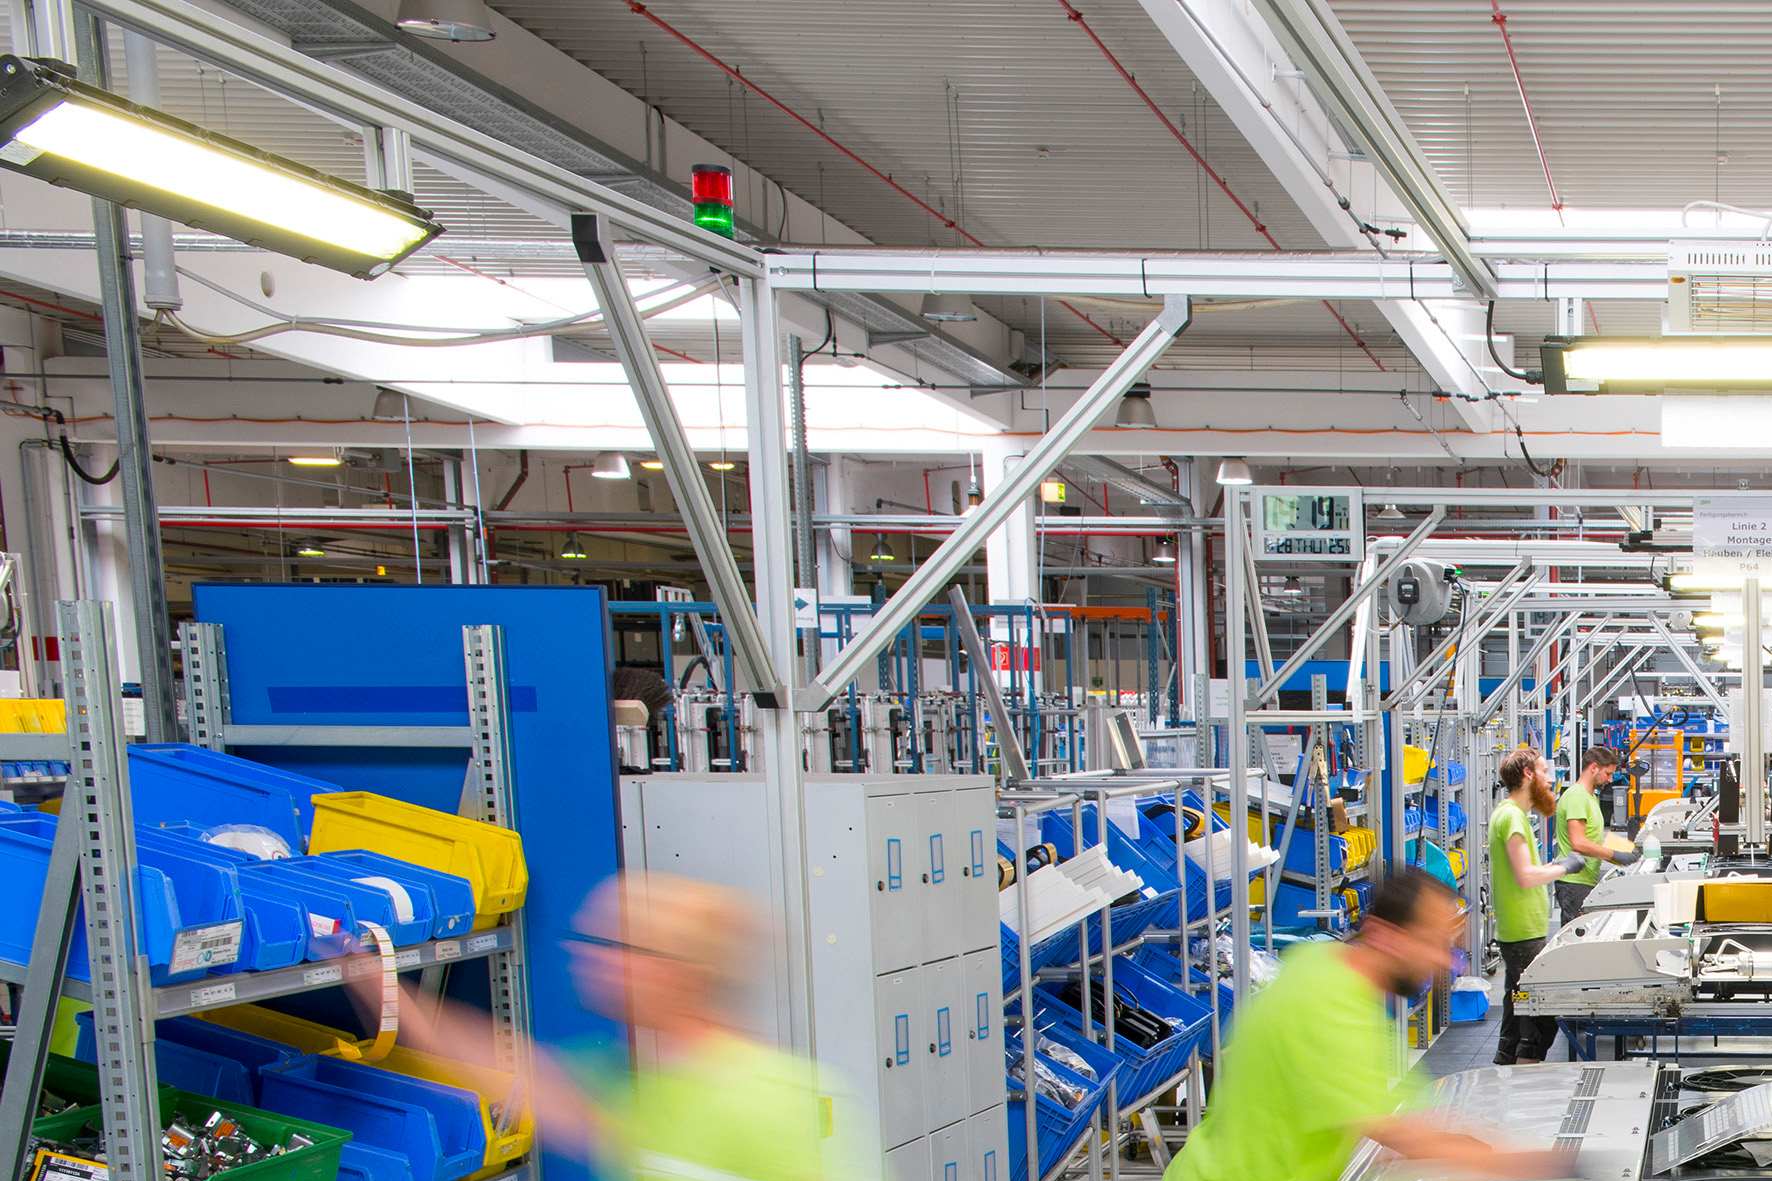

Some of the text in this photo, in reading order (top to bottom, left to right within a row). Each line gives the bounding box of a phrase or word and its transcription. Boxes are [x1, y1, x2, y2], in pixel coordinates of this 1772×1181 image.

[1732, 522, 1767, 531] Linie 2
[1727, 535, 1772, 545] Montage
[1703, 549, 1743, 558] Hauben
